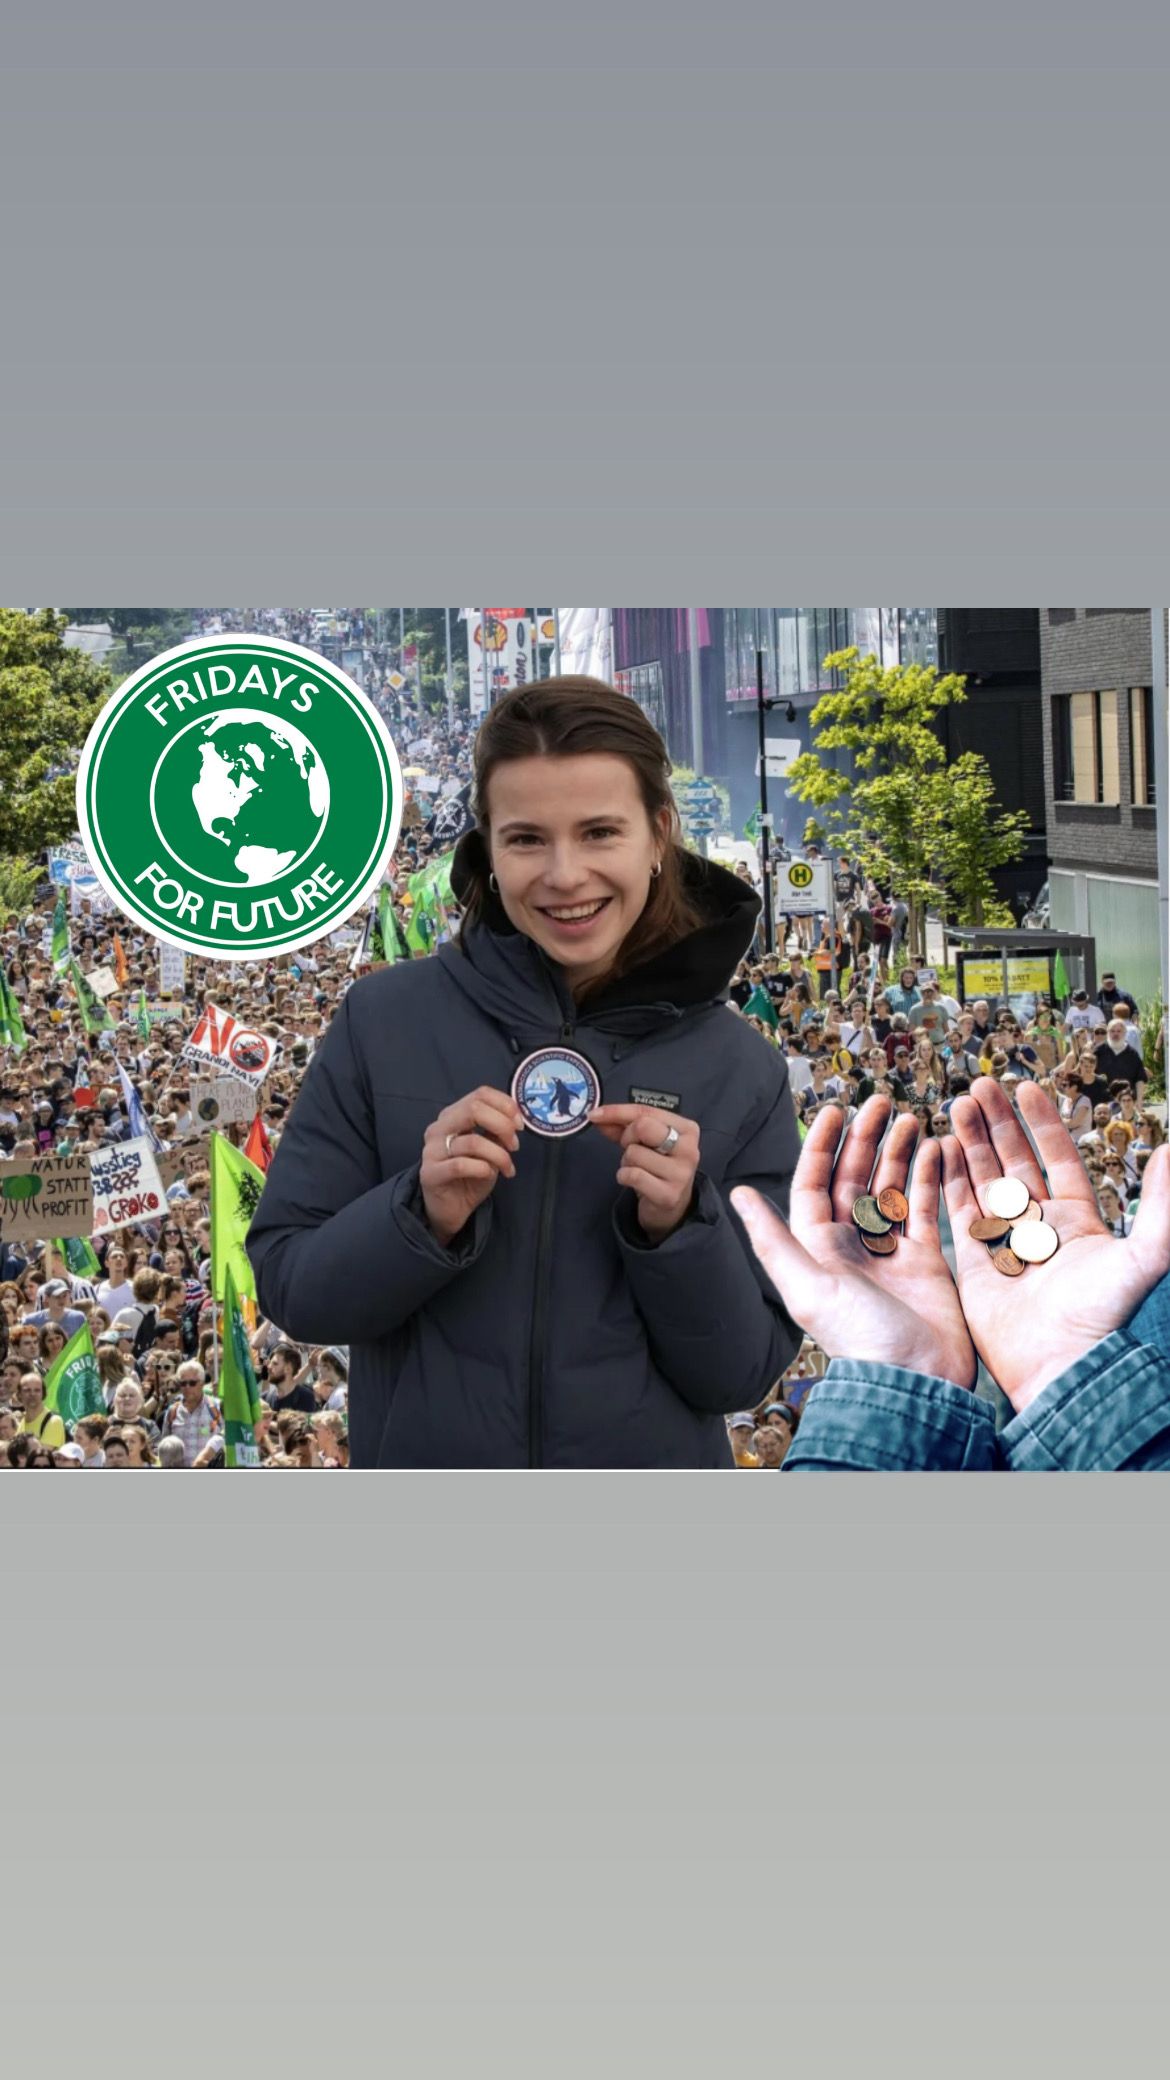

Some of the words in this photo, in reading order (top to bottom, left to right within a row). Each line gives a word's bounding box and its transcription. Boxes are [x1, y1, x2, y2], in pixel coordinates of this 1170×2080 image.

[794, 868, 807, 883] H
[184, 1045, 230, 1069] GRANDI
[230, 1066, 260, 1087] NAVI
[221, 1095, 255, 1111] PLANET
[31, 1158, 86, 1173] NATUR
[47, 1177, 90, 1195] STATT
[42, 1198, 89, 1219] PROFIT
[108, 1192, 159, 1223] GROKO
